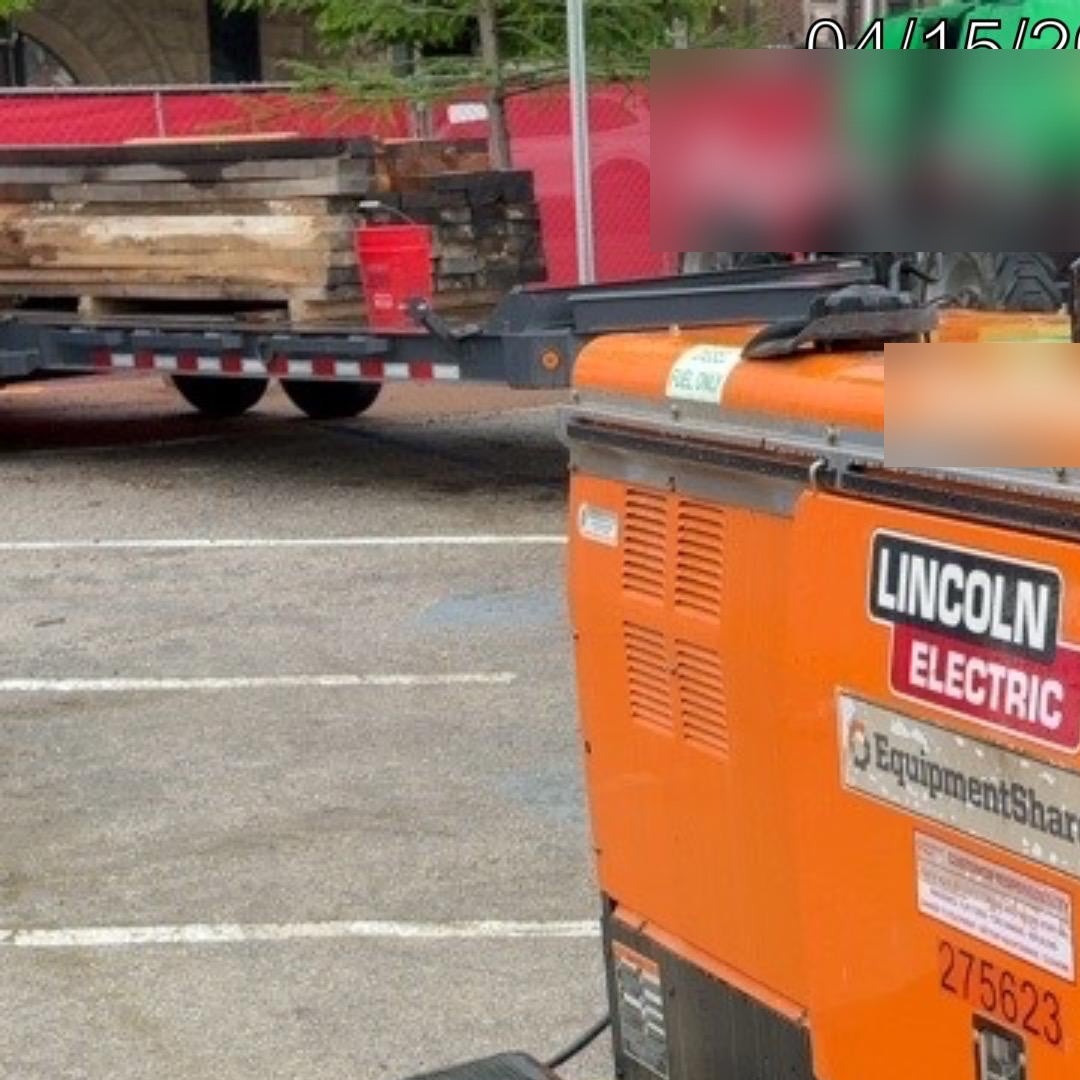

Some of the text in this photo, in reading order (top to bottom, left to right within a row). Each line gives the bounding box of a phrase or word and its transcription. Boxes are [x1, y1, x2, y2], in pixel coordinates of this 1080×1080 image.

[877, 547, 1049, 651] LINCOLN
[908, 640, 1064, 730] ELECTRIC
[939, 940, 1063, 1045] 275623
